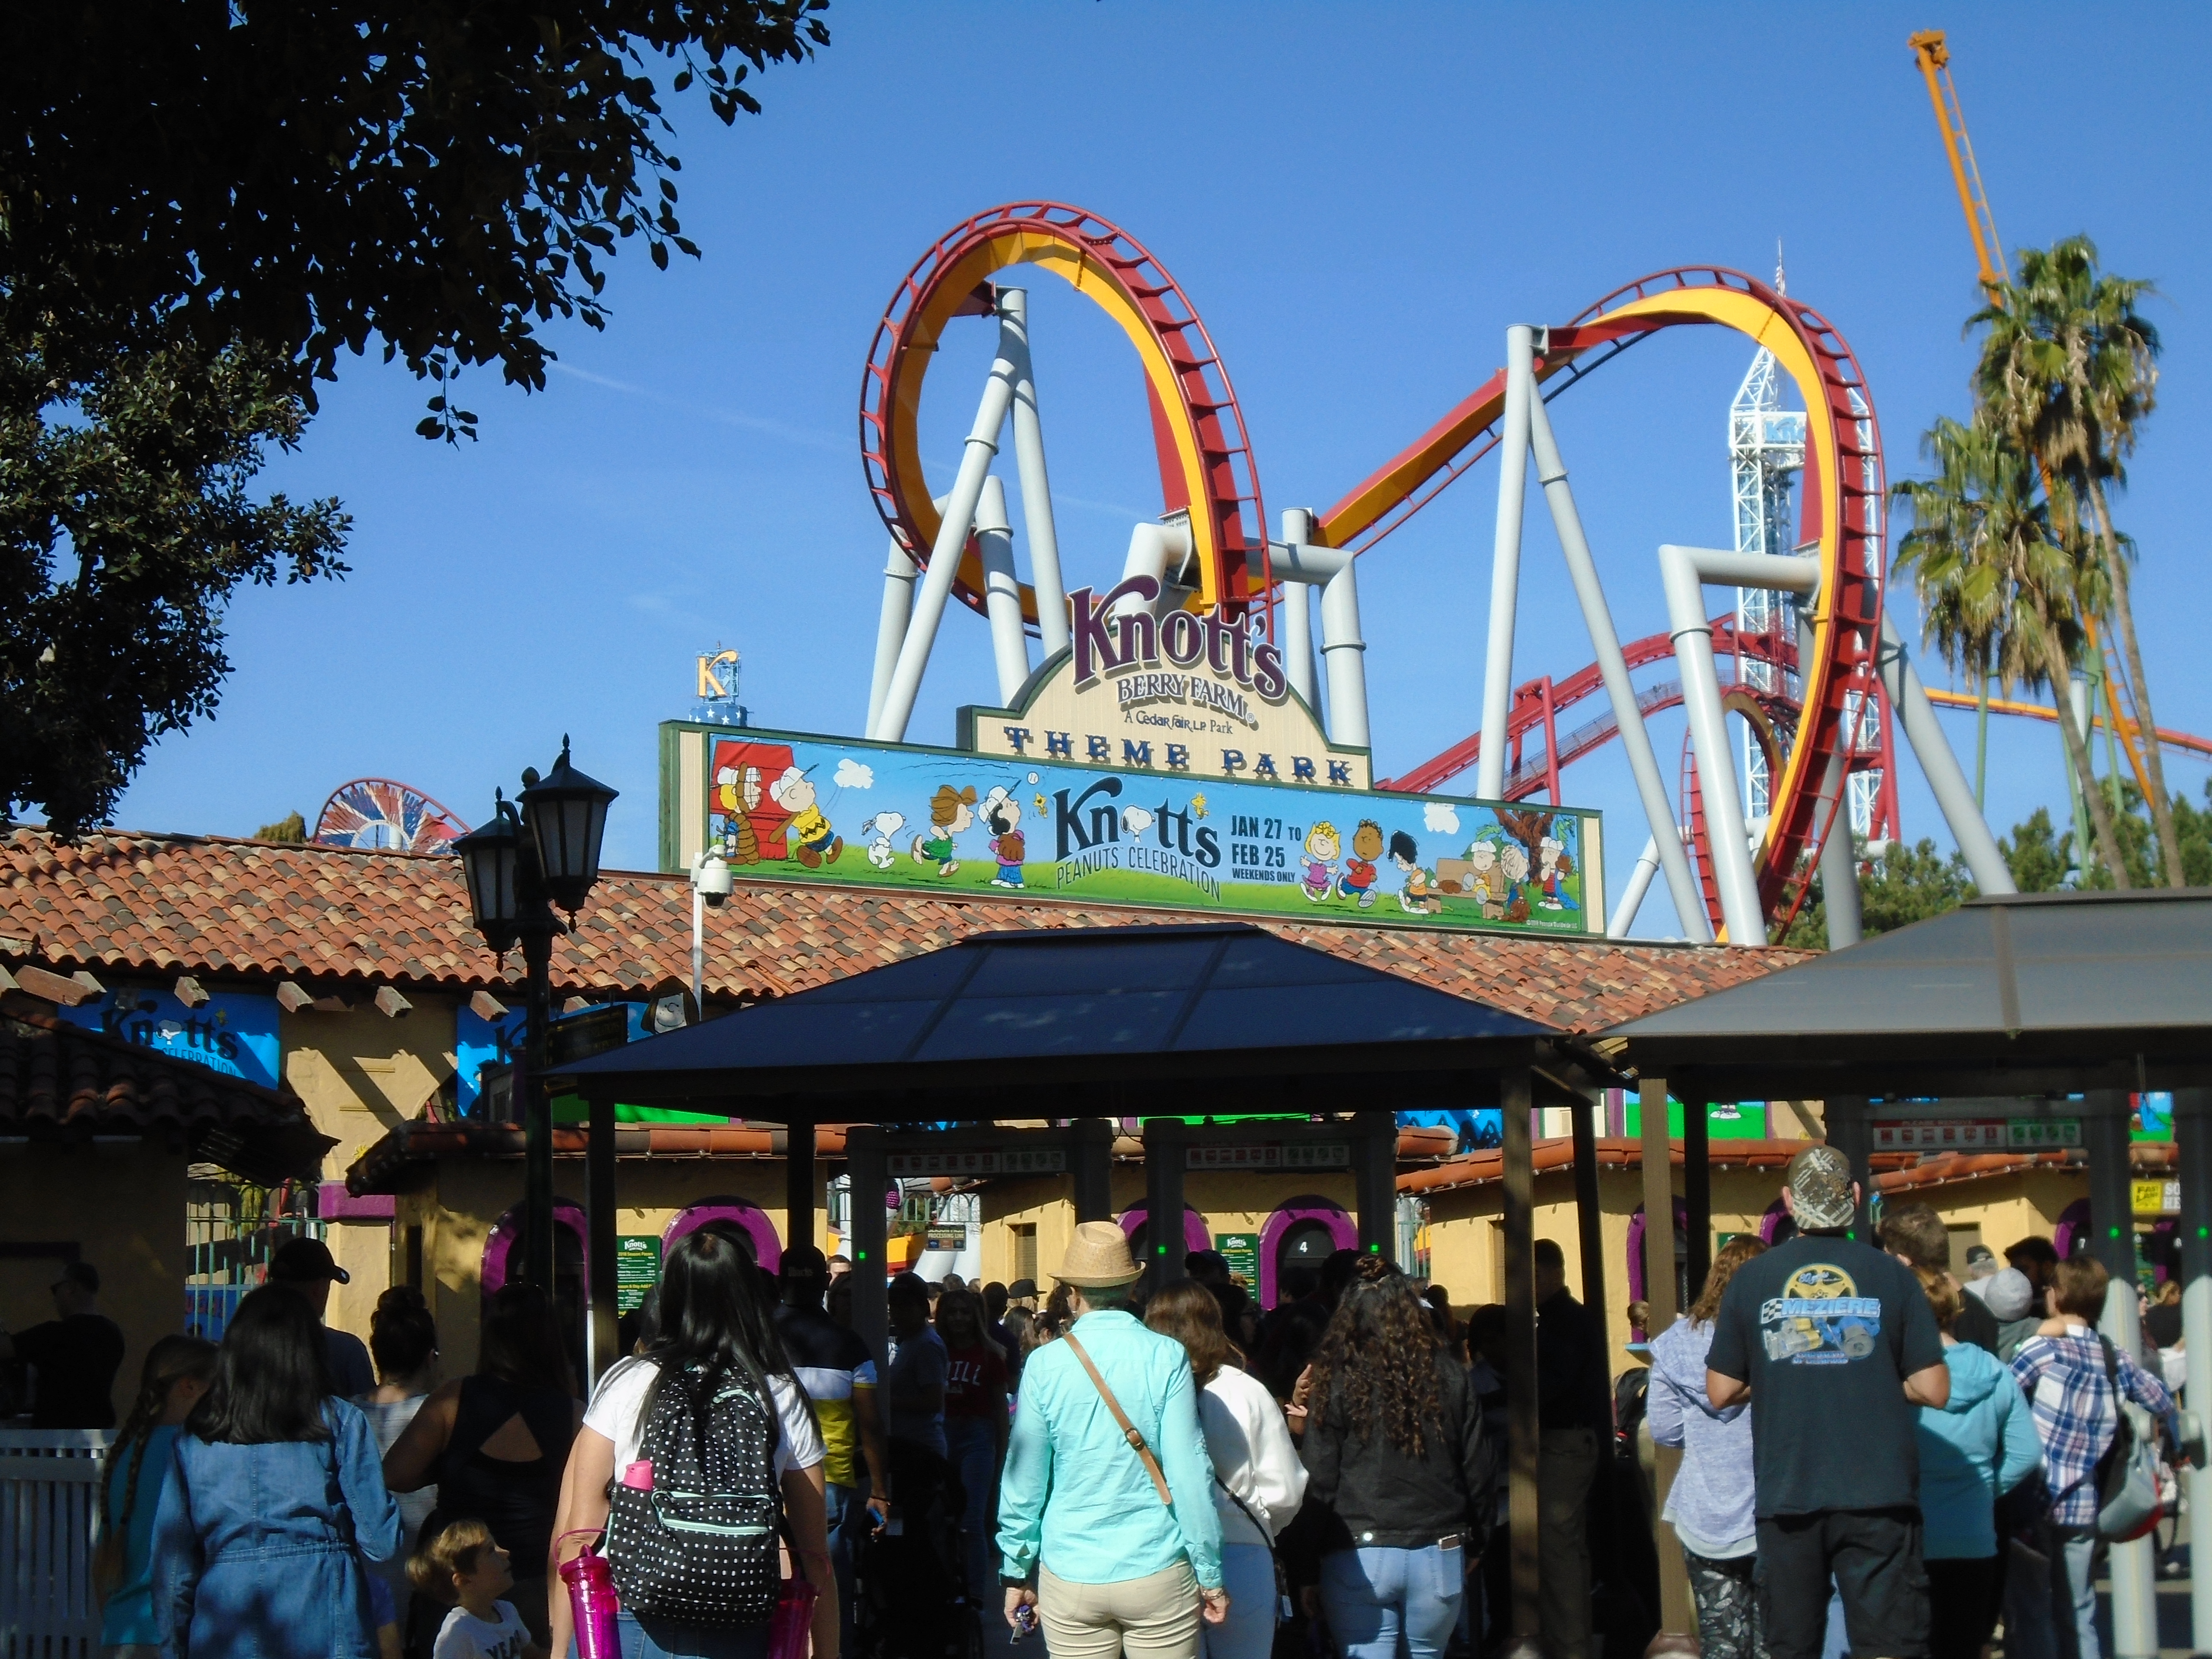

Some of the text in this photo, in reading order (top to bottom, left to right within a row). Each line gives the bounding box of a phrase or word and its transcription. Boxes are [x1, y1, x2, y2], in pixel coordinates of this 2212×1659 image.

[1067, 574, 1287, 699] Knott's
[698, 650, 738, 696] K
[1116, 673, 1244, 719] BERRY FARM
[1124, 710, 1133, 723] A
[1136, 710, 1173, 729] Cedar
[1210, 719, 1233, 734] Park
[1003, 726, 1352, 784] THEME PARK
[1231, 815, 1301, 841] JAN 27 TO
[1232, 843, 1285, 868] FEB 25
[1057, 846, 1221, 902] PEANUTS CELEBRATION
[1232, 868, 1295, 882] WEEKENDS ONLY
[1300, 1242, 1308, 1252] 4
[2079, 1238, 2086, 1249] 7
[1781, 1299, 1880, 1315] MEZIERE
